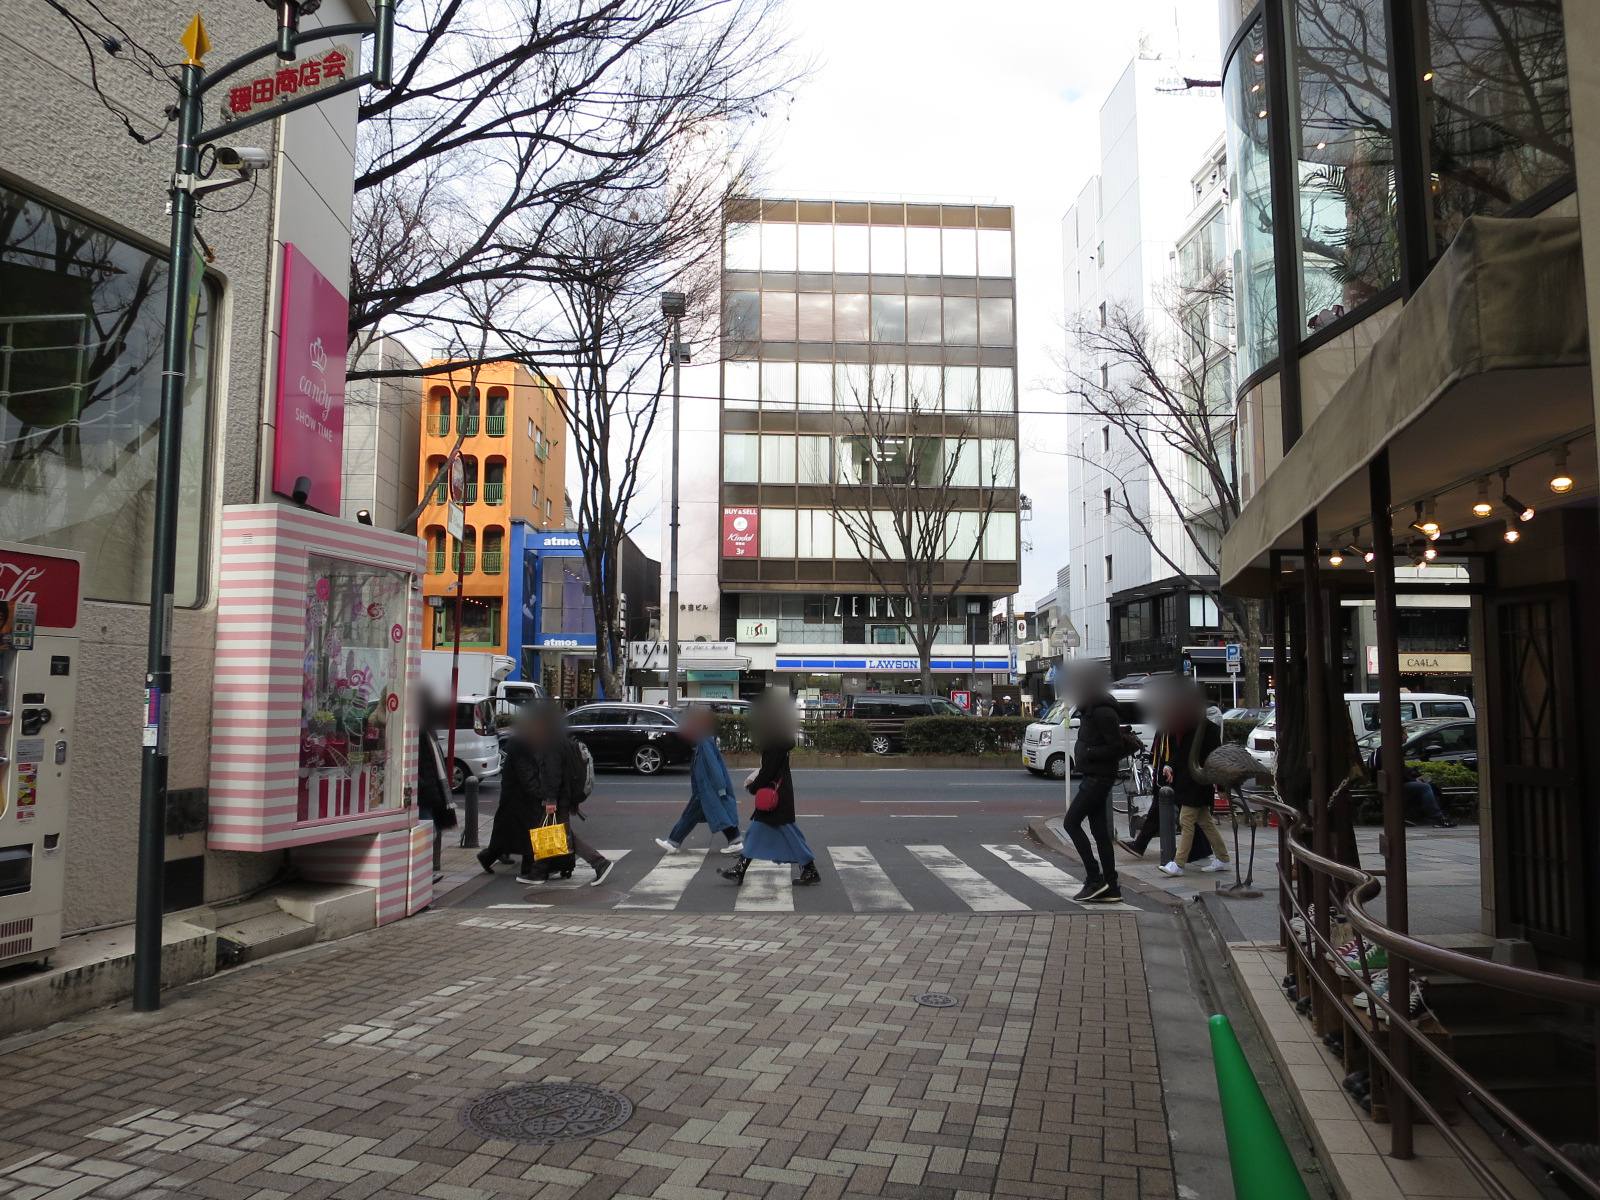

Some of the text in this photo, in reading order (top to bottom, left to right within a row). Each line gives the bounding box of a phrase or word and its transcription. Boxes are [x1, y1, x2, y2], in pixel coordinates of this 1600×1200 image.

[229, 51, 346, 113] 穏田商店会
[299, 376, 332, 421] candy
[295, 408, 333, 442] SHOW TIME
[833, 596, 912, 618] ZENKO
[543, 638, 578, 647] atmos
[1227, 646, 1238, 661] P
[1407, 658, 1439, 667] CA4LA
[868, 660, 919, 669] LAWSON
